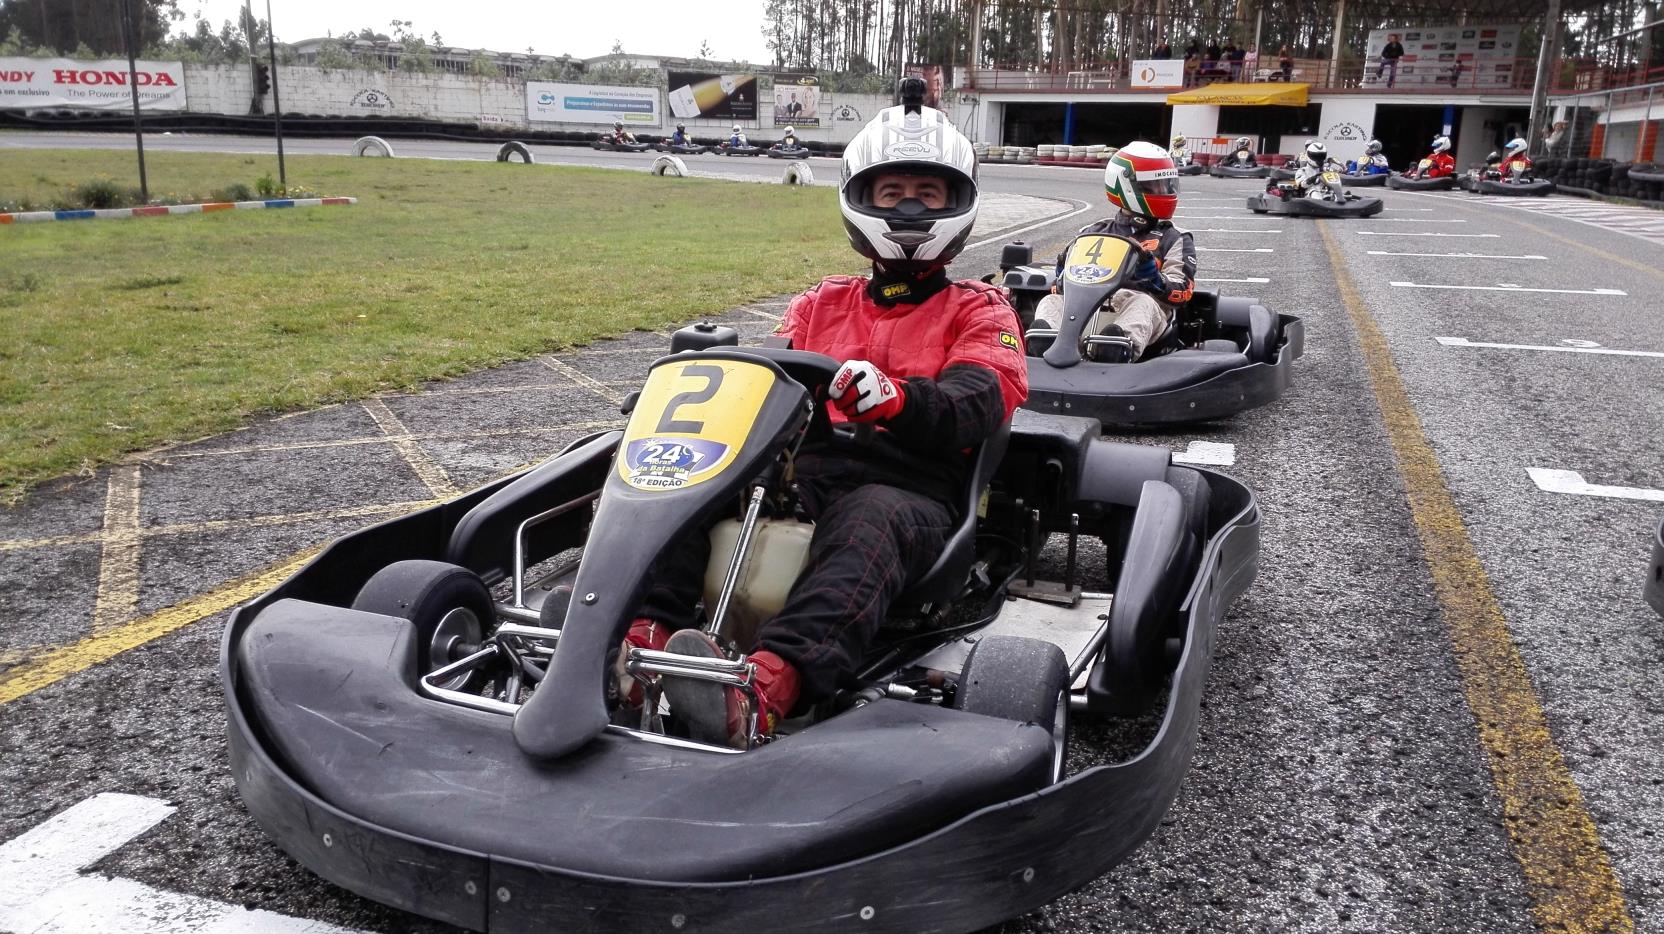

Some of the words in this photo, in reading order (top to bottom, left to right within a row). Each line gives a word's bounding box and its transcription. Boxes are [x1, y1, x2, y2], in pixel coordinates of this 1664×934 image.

[53, 69, 178, 87] HONDA
[17, 88, 50, 97] exclusivo
[68, 88, 86, 98] The
[90, 89, 119, 99] Power
[121, 89, 131, 98] of
[1085, 237, 1105, 265] 4
[883, 284, 908, 297] OMP
[836, 368, 853, 391] OMP
[654, 364, 725, 434] 2
[643, 445, 681, 463] 24
[650, 465, 686, 474] Batalha
[646, 478, 683, 488] EDIÇÃO
